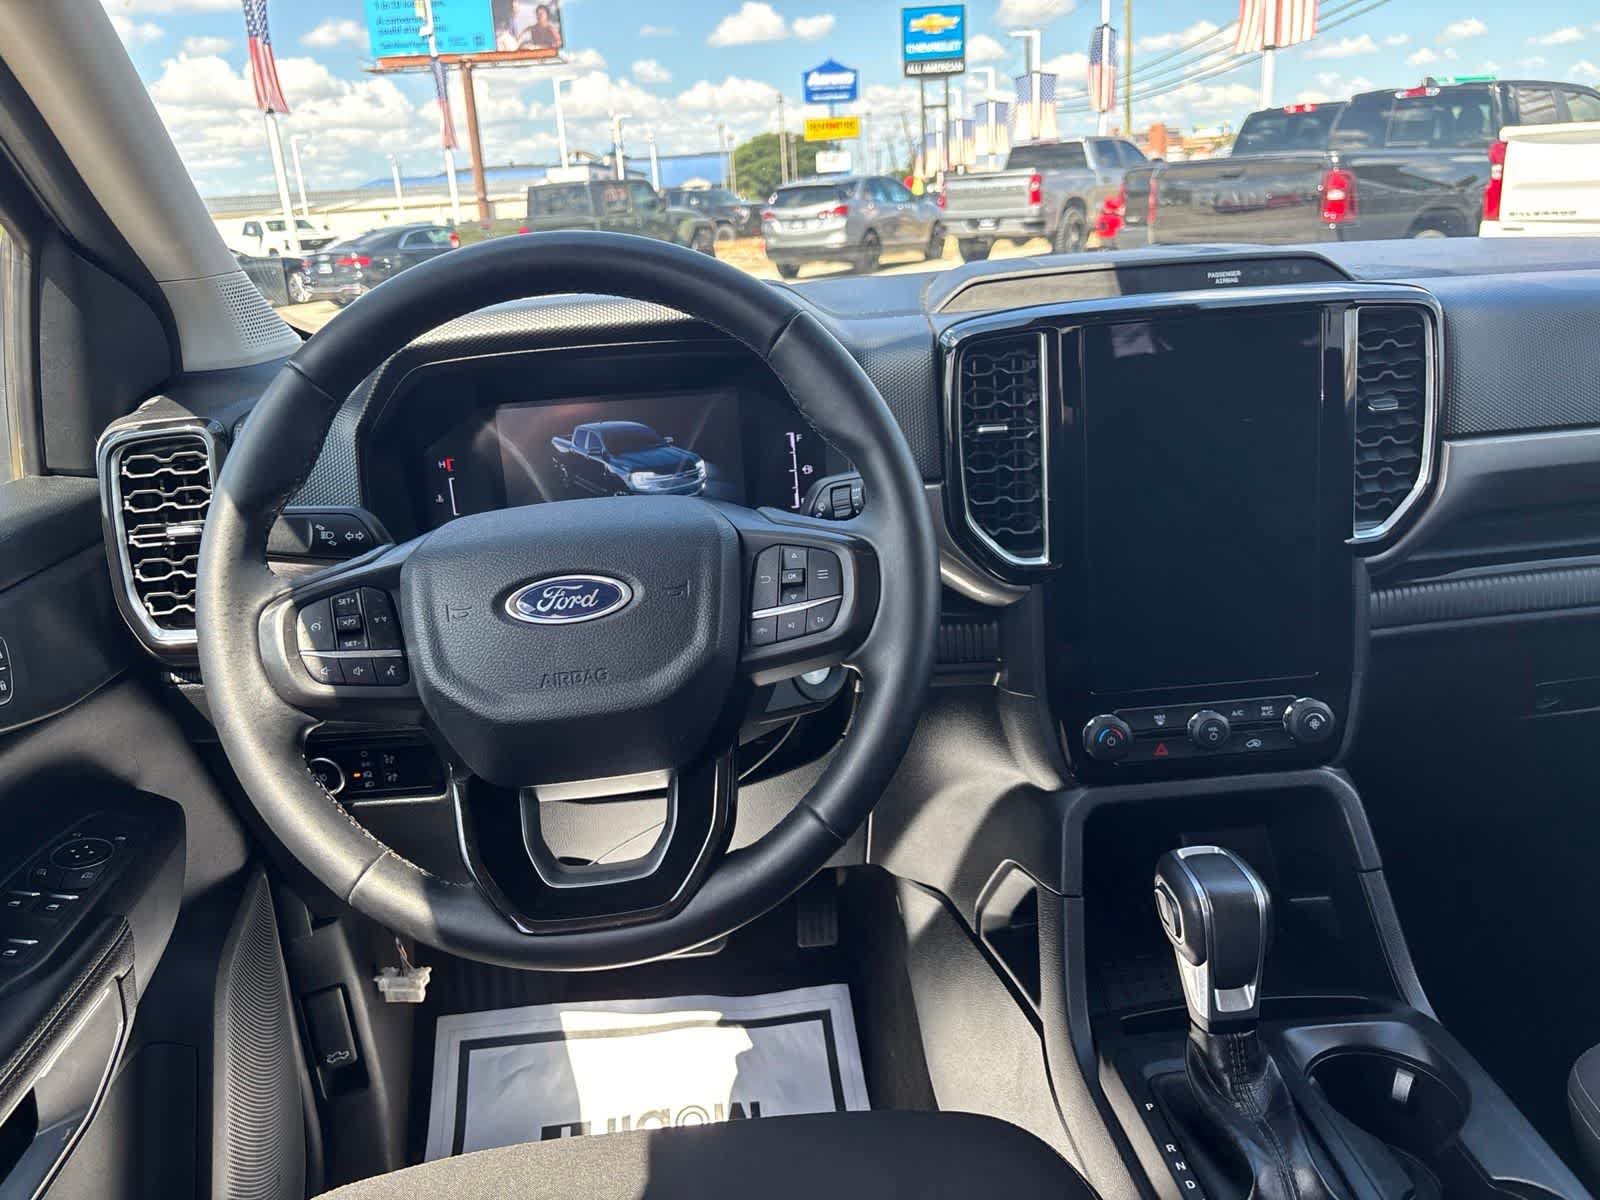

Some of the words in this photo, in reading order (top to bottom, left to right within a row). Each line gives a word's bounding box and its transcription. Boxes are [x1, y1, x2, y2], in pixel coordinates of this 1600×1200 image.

[536, 585, 600, 613] Ford
[540, 667, 609, 689] AIRBAG
[1231, 709, 1245, 717] A/C
[1145, 1103, 1154, 1111] P
[1166, 1144, 1176, 1152] R
[1175, 1161, 1187, 1171] N
[1185, 1180, 1196, 1190] D
